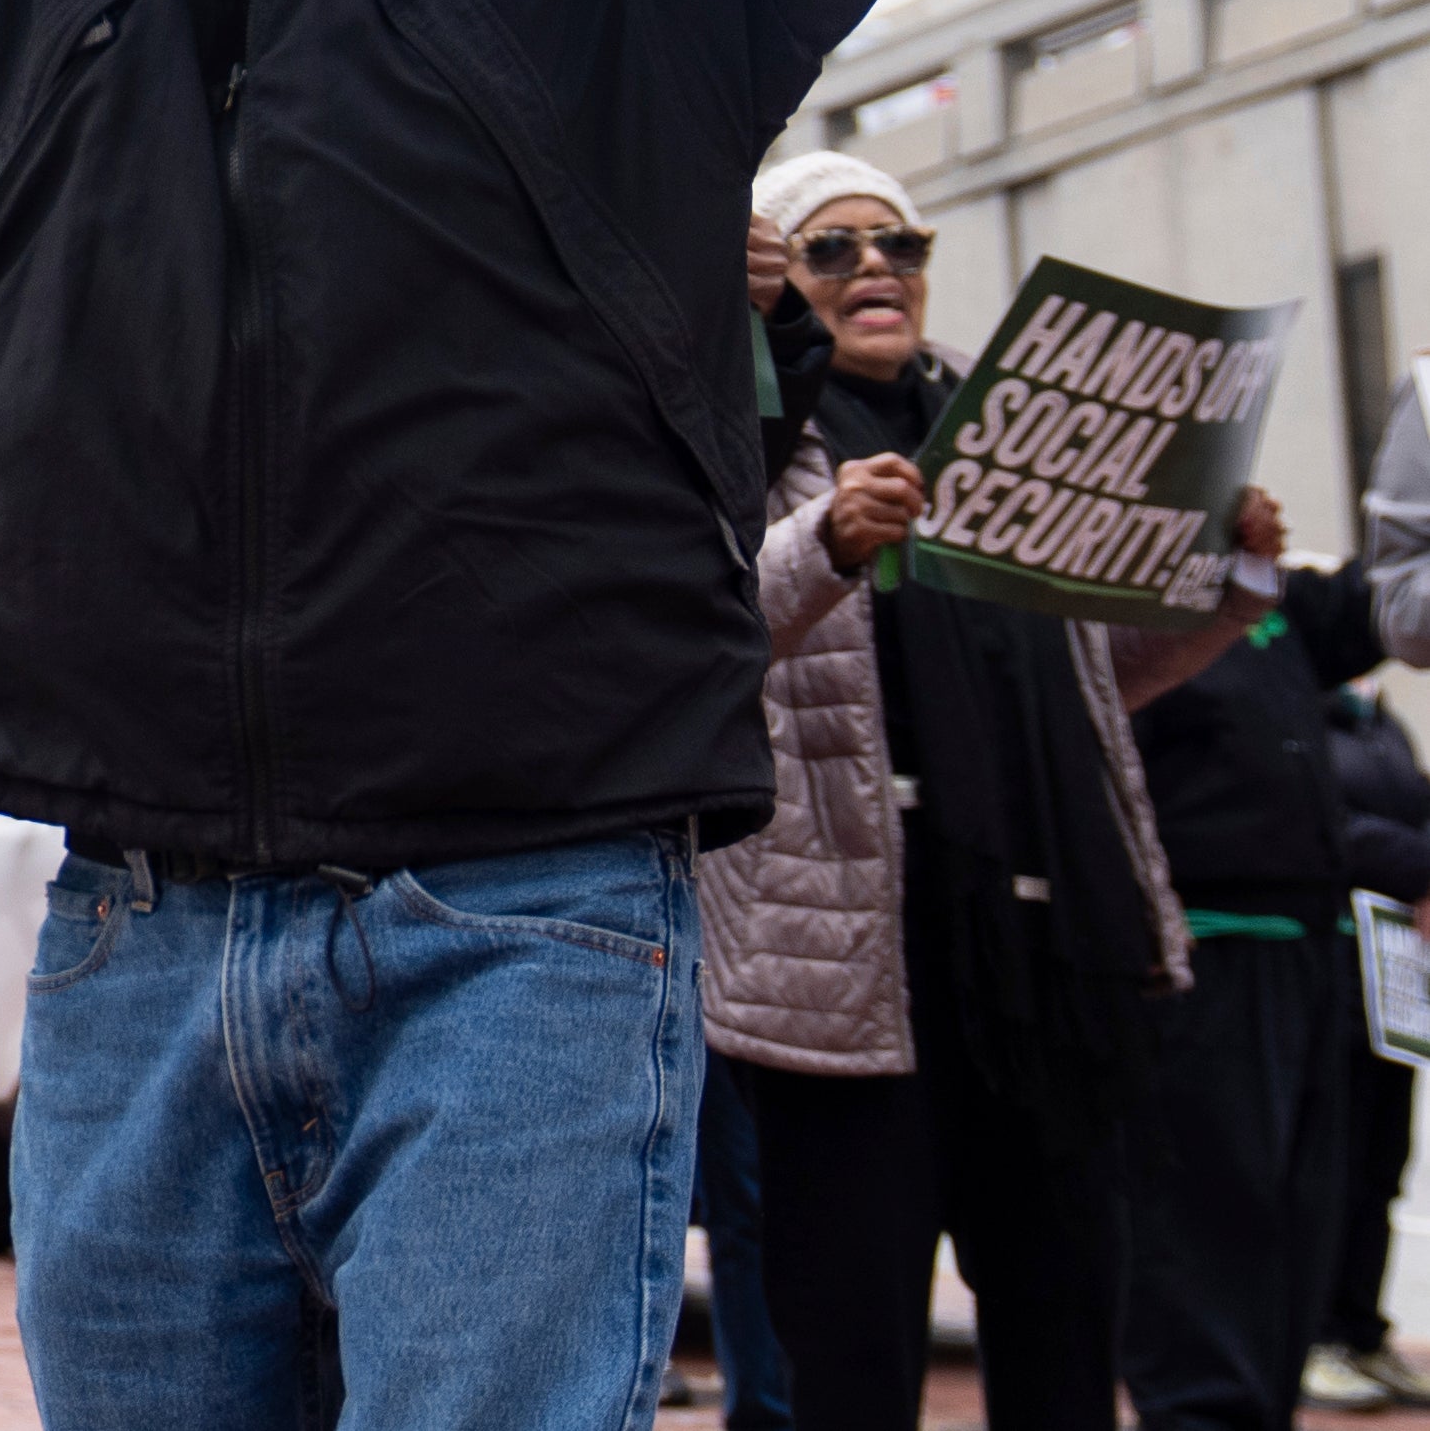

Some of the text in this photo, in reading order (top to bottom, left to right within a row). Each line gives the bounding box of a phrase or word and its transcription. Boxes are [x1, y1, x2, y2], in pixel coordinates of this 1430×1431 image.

[996, 293, 1222, 417] HANDS
[954, 378, 1180, 500] SOCIAL
[915, 458, 1209, 583] SECURITY!
